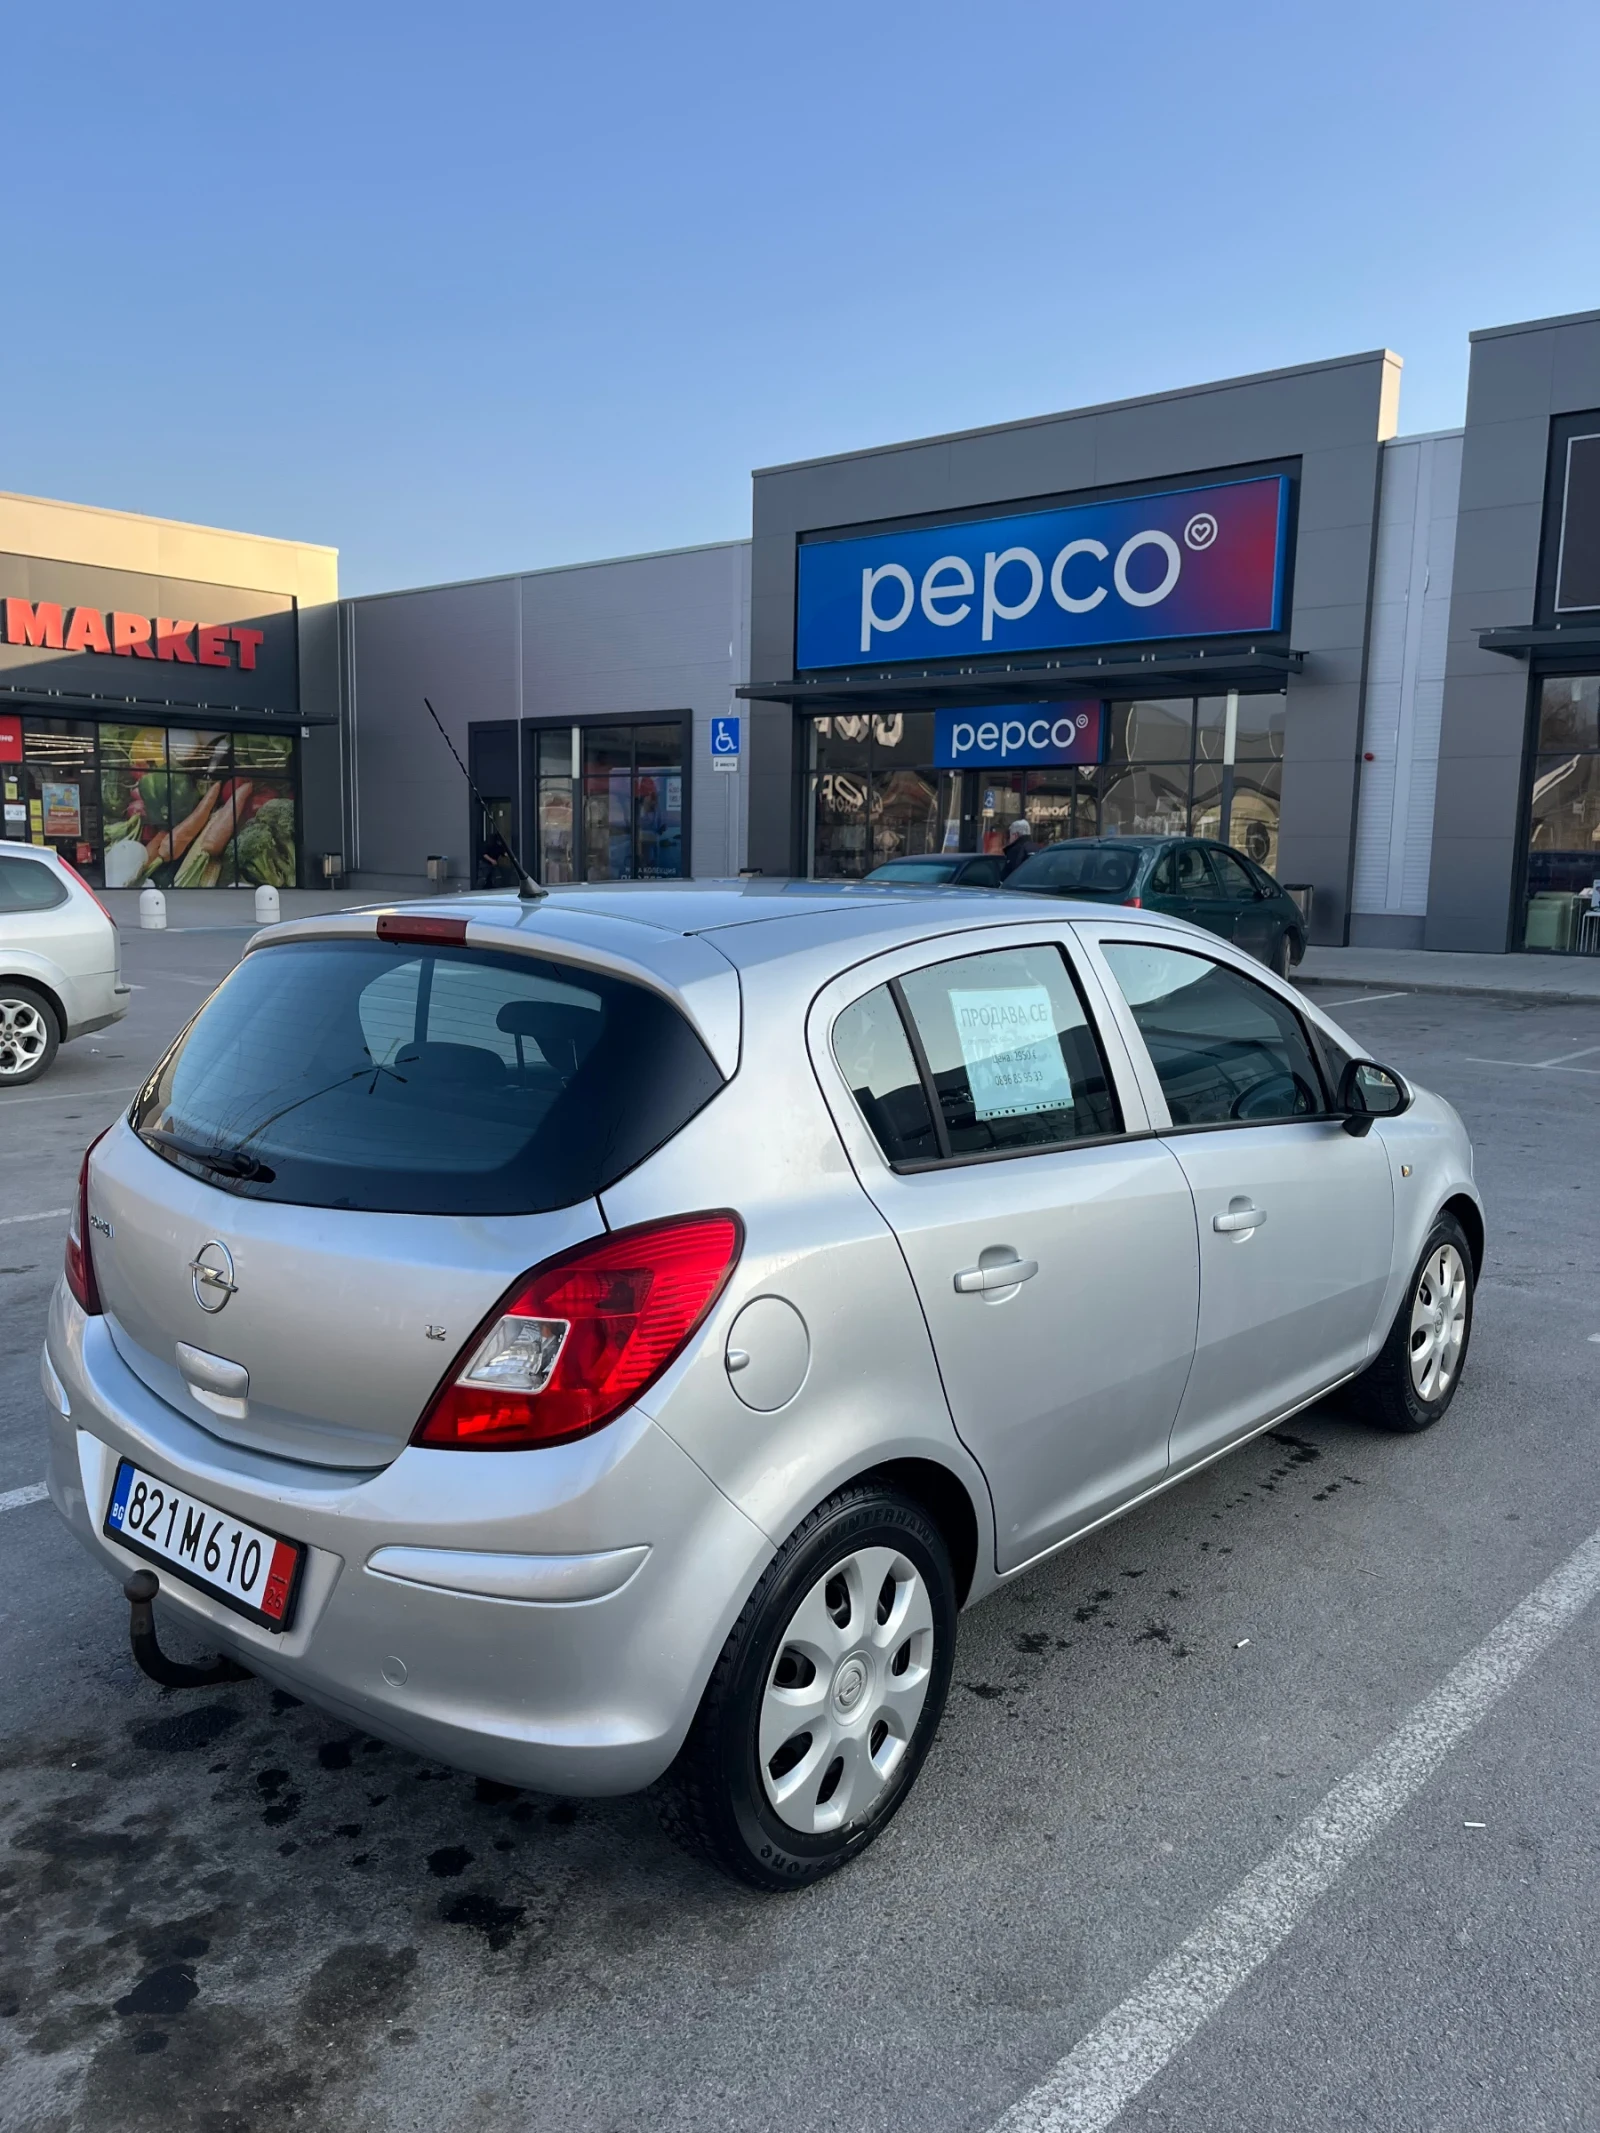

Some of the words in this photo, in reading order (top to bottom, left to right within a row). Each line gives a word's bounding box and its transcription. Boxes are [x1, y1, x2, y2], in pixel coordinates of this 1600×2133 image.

[860, 529, 1181, 652] pepco
[5, 597, 264, 670] MARKET
[951, 716, 1077, 759] pepco
[961, 1006, 1028, 1029] ПРОДАВА
[1030, 1004, 1047, 1022] СЕ
[112, 1502, 125, 1521] BG
[265, 1586, 284, 1610] 26
